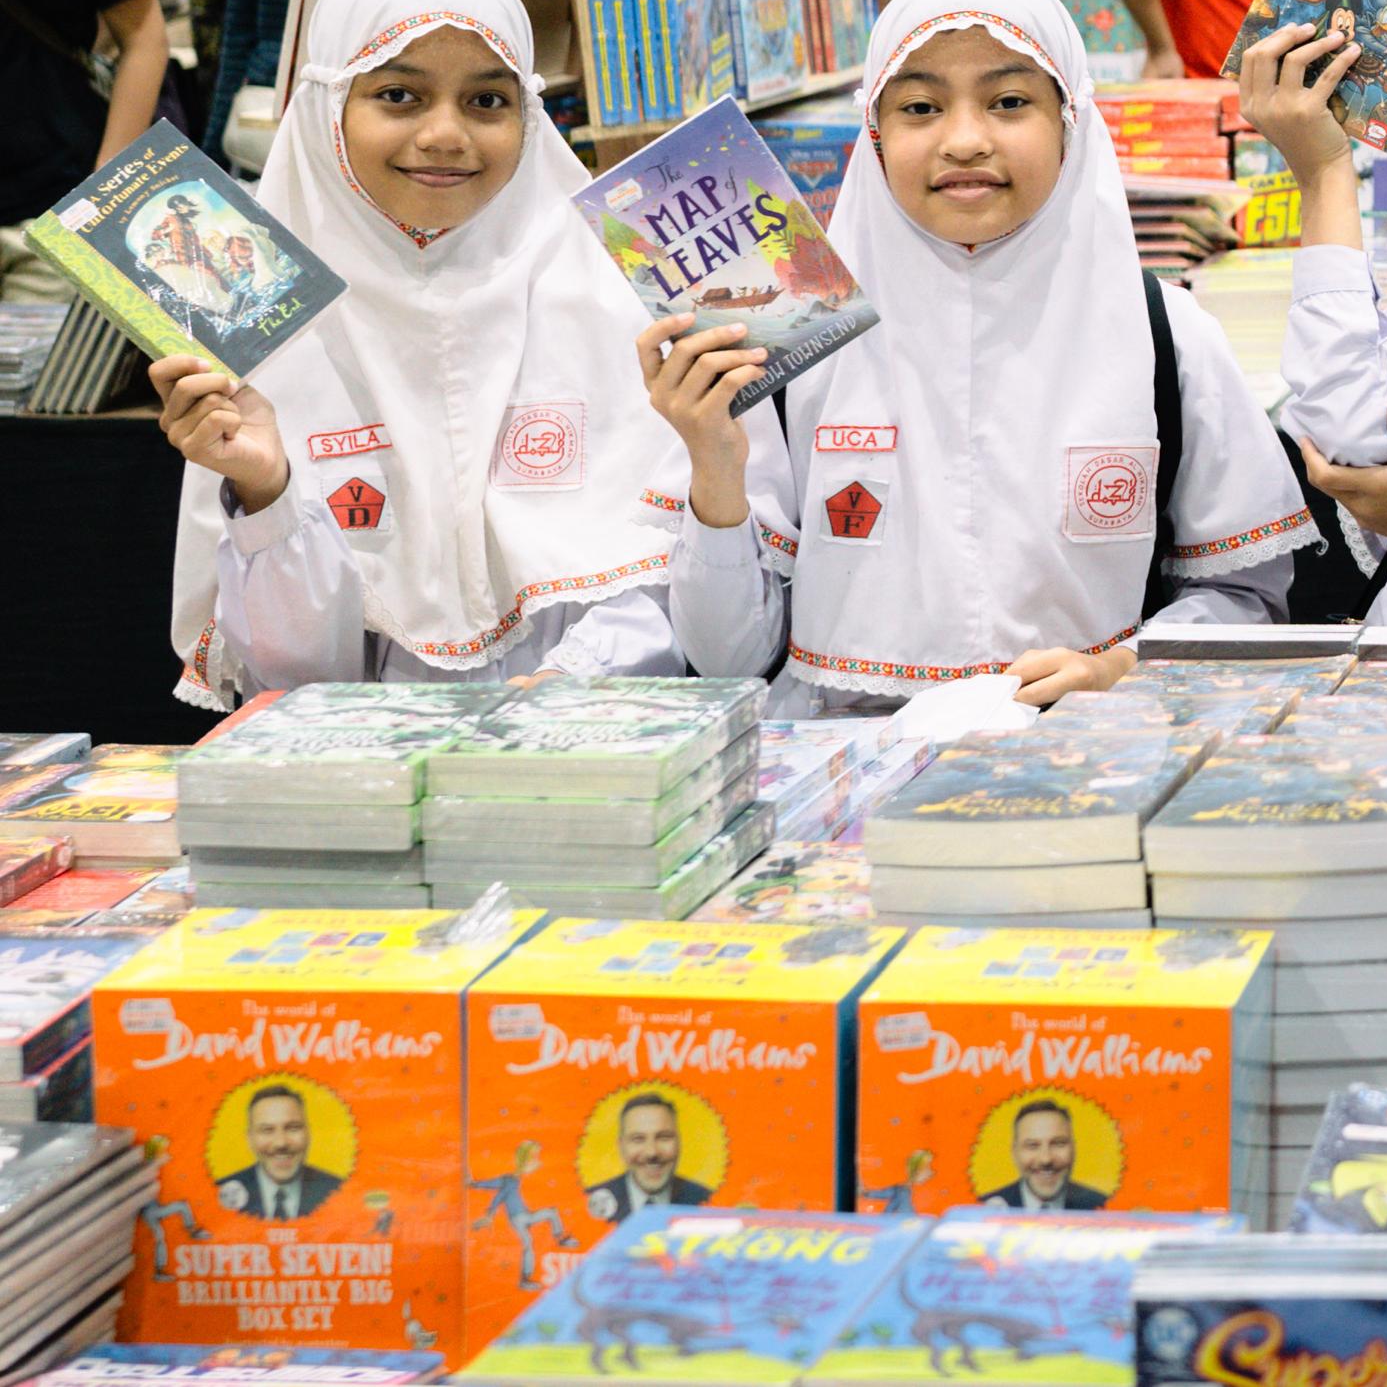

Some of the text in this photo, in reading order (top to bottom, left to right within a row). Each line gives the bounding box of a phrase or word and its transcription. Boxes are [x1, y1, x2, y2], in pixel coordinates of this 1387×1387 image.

[147, 143, 190, 176] Events
[97, 157, 145, 194] Series
[647, 160, 685, 191] The
[644, 167, 740, 249] MAP of
[648, 191, 788, 302] LEAVES
[257, 297, 306, 336] The End
[782, 315, 858, 373] TOWNSEND
[321, 430, 381, 454] SYILA
[832, 430, 878, 448] UCA
[348, 486, 362, 502] V
[848, 491, 861, 510] V
[347, 507, 371, 528] D
[843, 514, 866, 535] F
[242, 1000, 337, 1019] The world of
[617, 1007, 713, 1027] The world of
[1011, 1012, 1107, 1033] The world of
[133, 1018, 444, 1070] David Walliams
[506, 1024, 818, 1077] David Walliams
[897, 1032, 1212, 1084] David Walliams
[174, 1242, 393, 1279] SUPER SEVEN!
[177, 1279, 394, 1306] BRILLIANTLY BIG
[236, 1304, 335, 1332] BOX SET
